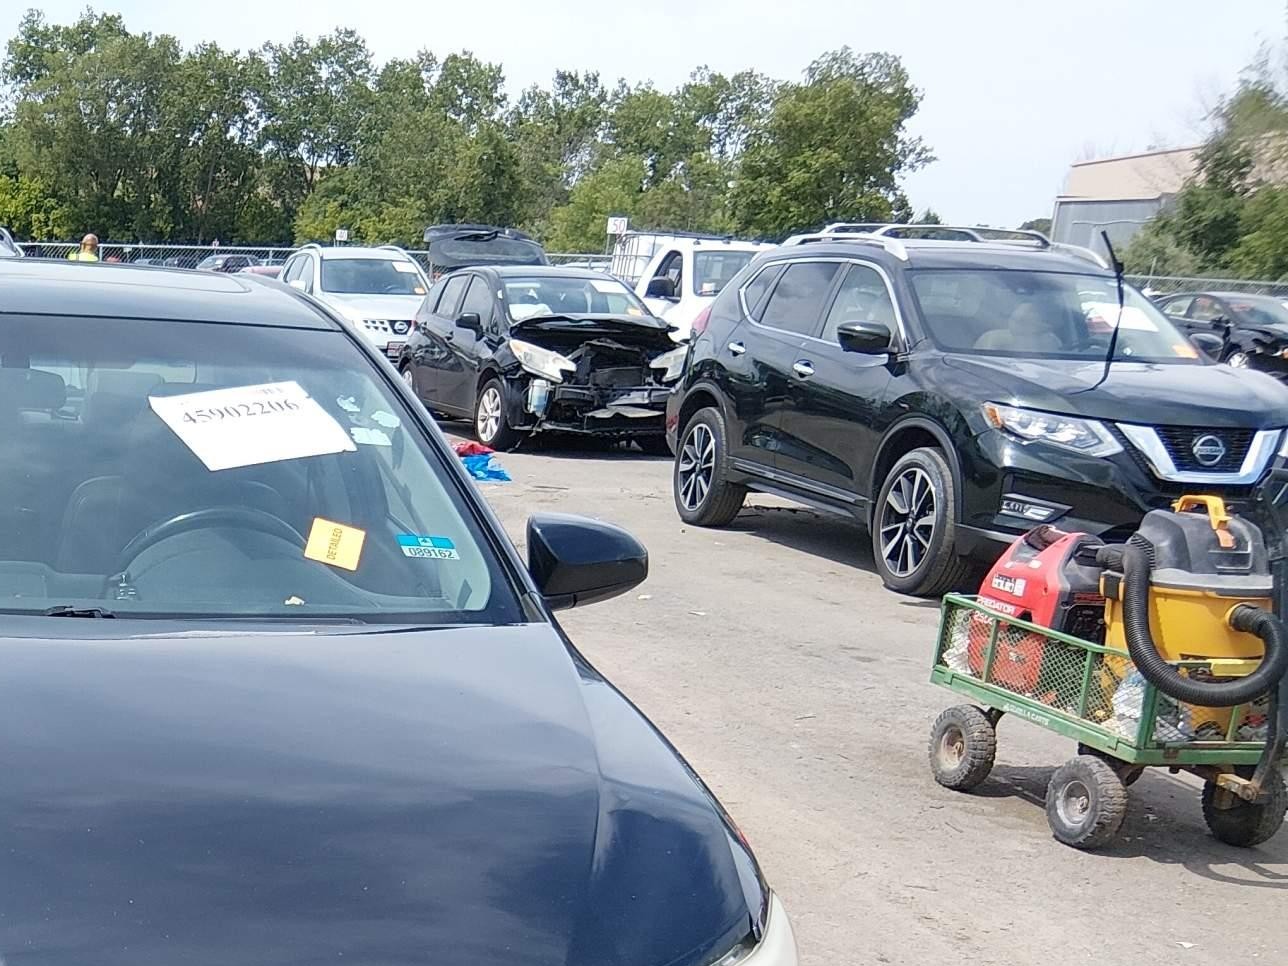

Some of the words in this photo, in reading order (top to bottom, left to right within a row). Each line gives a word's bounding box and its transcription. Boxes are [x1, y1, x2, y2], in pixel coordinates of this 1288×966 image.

[182, 398, 300, 425] 45902206
[325, 527, 344, 561] DETAILED
[408, 547, 456, 560] 089162
